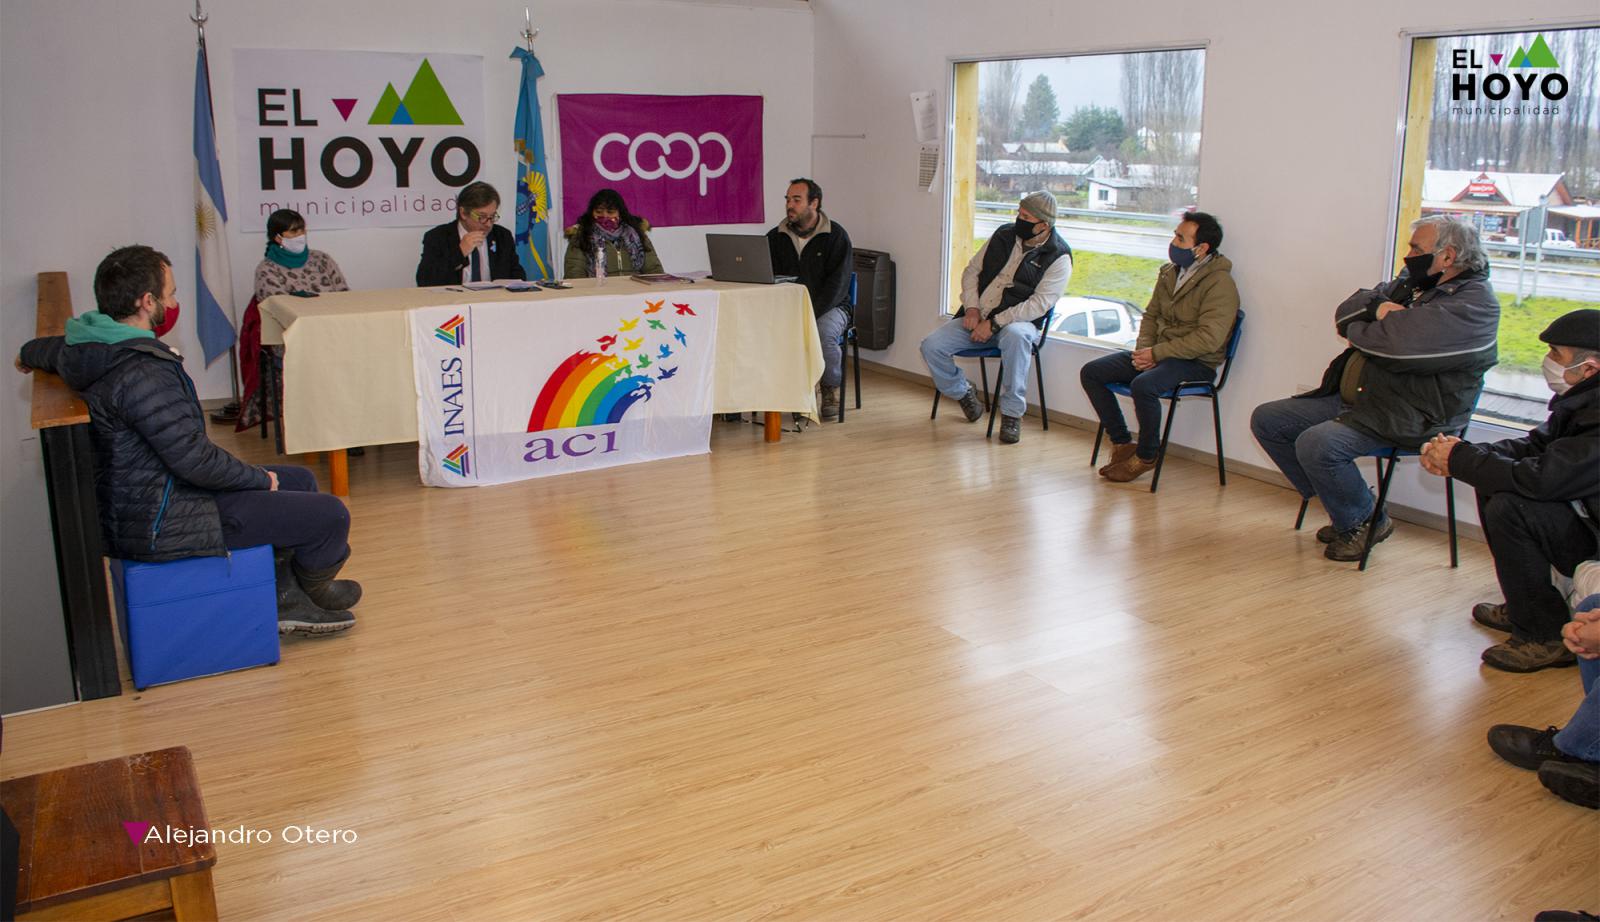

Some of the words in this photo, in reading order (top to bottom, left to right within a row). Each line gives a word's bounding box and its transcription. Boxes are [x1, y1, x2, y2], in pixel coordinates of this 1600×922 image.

[258, 88, 318, 127] EL
[259, 136, 481, 190] HOYO
[593, 132, 733, 196] coop
[441, 357, 465, 438] INAES
